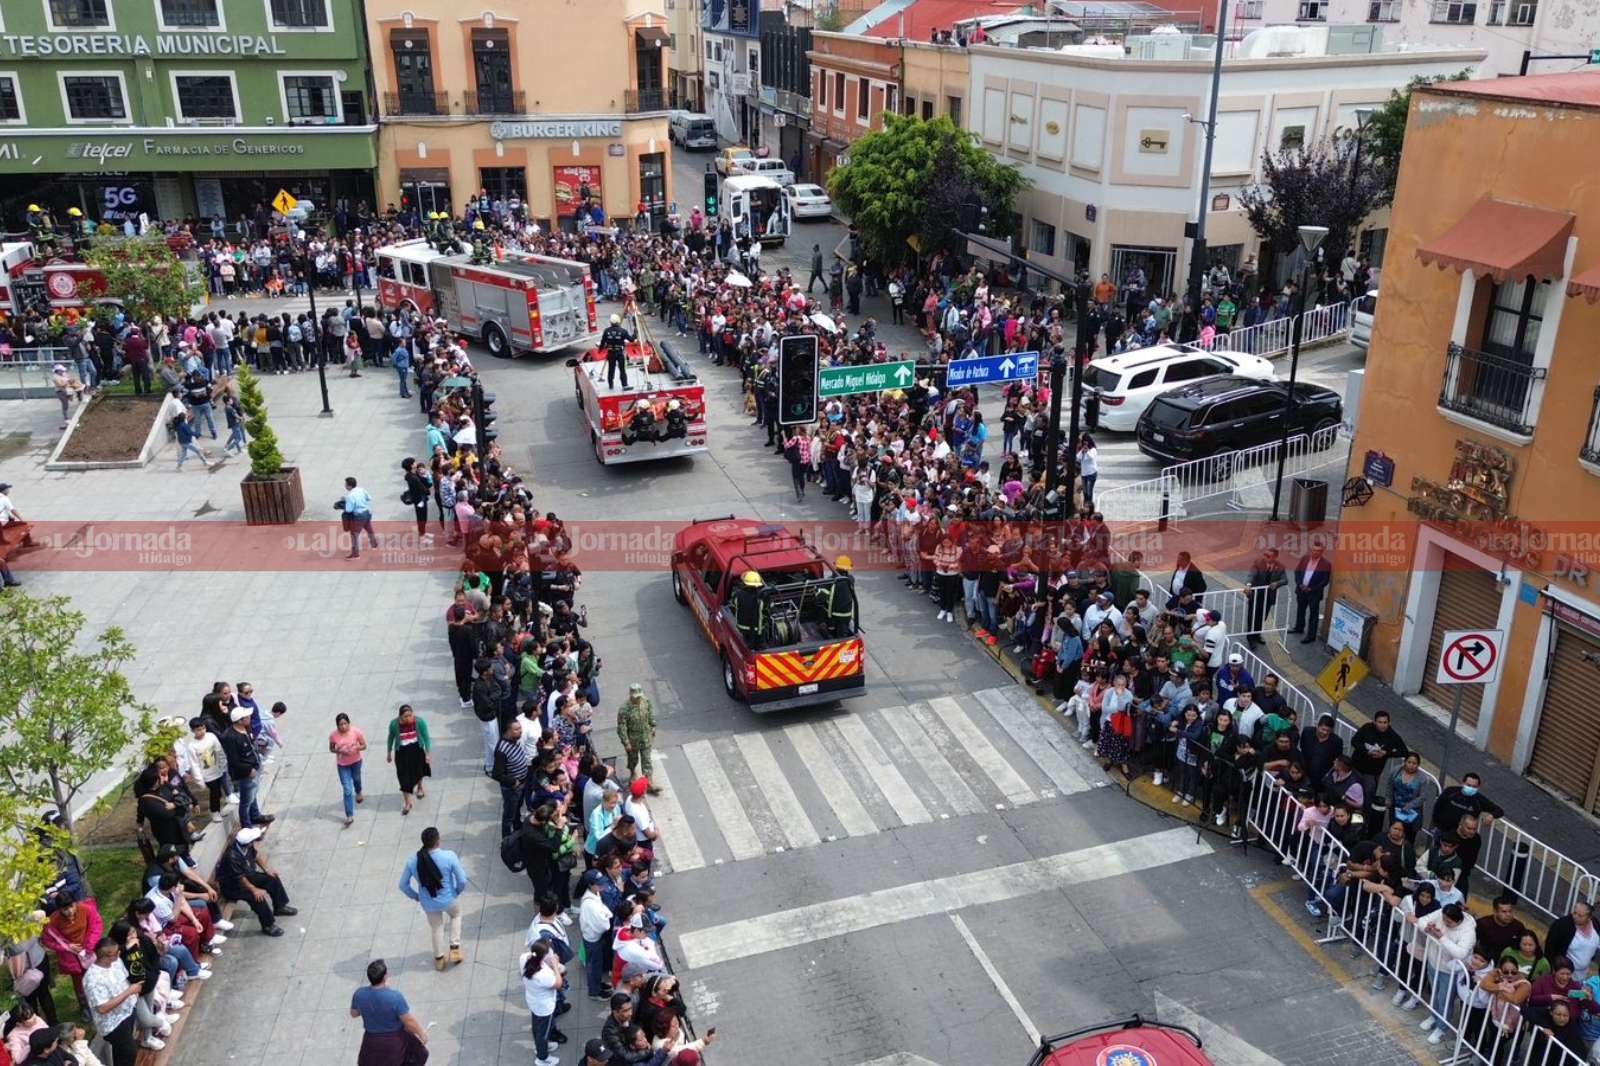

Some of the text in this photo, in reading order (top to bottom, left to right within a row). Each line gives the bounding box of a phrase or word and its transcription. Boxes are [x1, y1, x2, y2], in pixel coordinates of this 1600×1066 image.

[3, 35, 286, 55] TESORERIA MUNICIPAL
[513, 122, 619, 137] BURGER KING
[82, 142, 133, 158] telcel
[104, 186, 137, 208] 5G
[821, 371, 886, 391] Mercado Miguel Hidalgo
[966, 366, 972, 379] de
